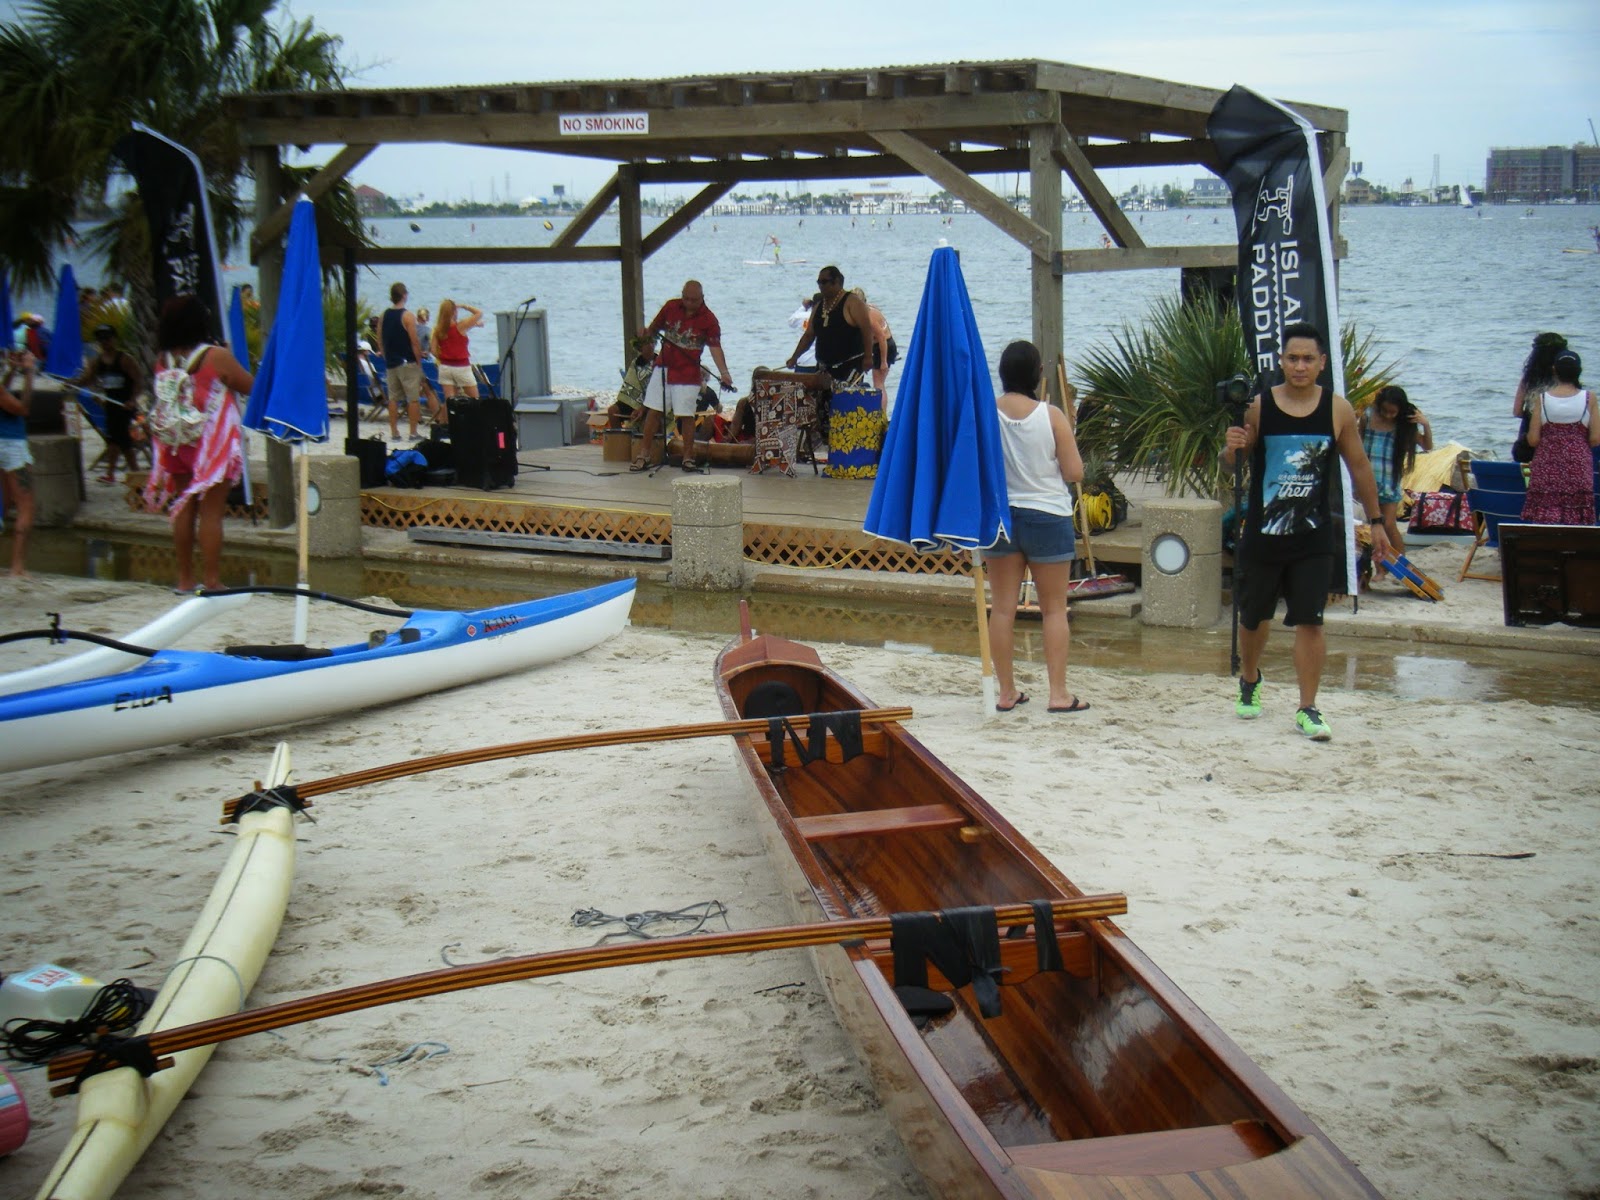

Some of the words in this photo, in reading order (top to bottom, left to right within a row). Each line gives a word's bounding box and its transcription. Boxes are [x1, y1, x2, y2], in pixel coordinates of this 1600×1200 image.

[563, 119, 581, 131] NO
[585, 117, 645, 131] SMOKING
[1251, 243, 1275, 373] PADDLE
[1279, 239, 1302, 327] ISLA
